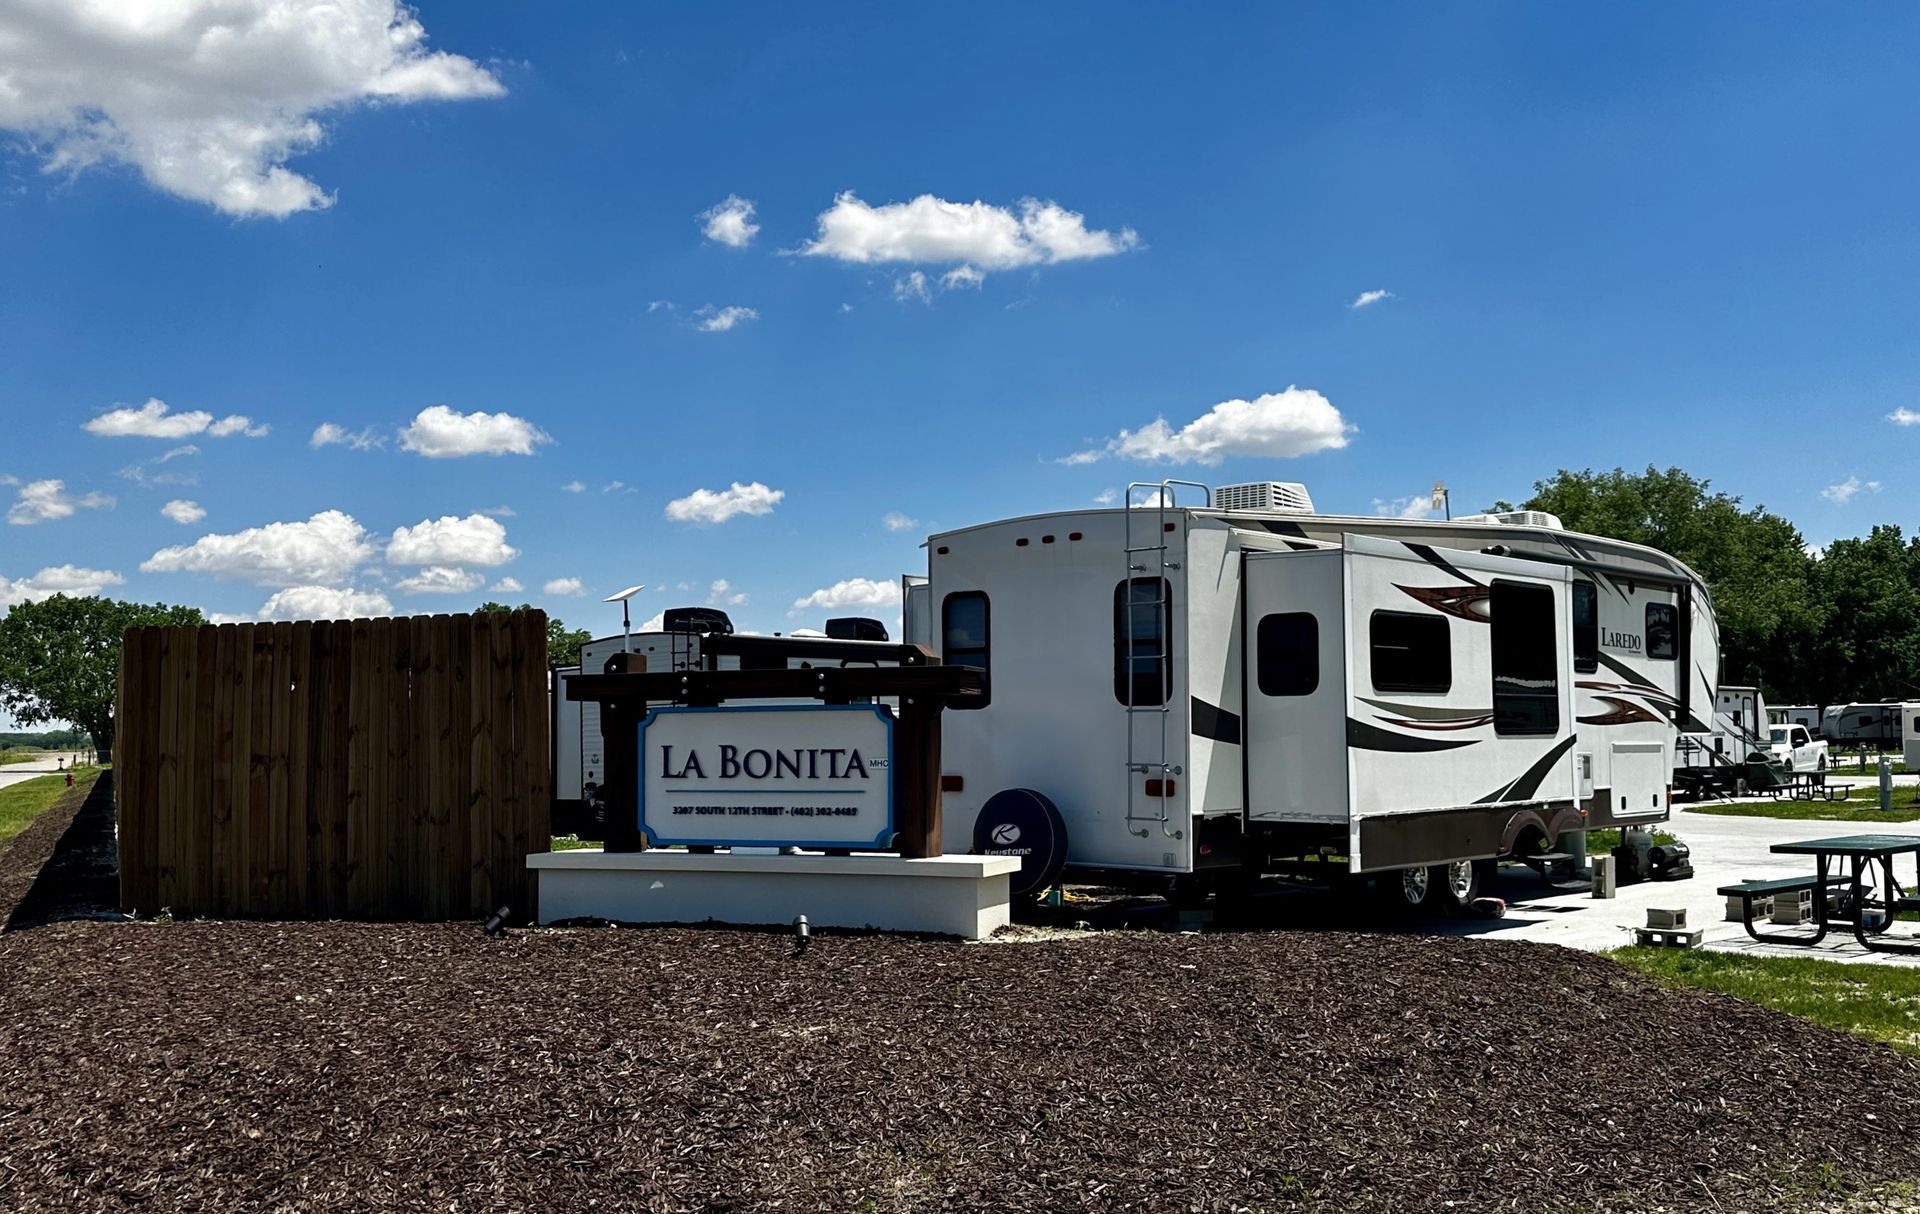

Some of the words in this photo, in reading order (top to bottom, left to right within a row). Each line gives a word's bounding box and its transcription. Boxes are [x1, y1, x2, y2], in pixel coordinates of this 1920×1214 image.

[1601, 626, 1641, 650] LAREDO
[660, 745, 708, 779] LA
[718, 744, 870, 779] BONITA
[870, 759, 889, 768] MHC
[695, 806, 725, 815] SOUTH
[727, 806, 750, 815] 12TH
[751, 806, 784, 815] STREET
[791, 806, 813, 817] (402)
